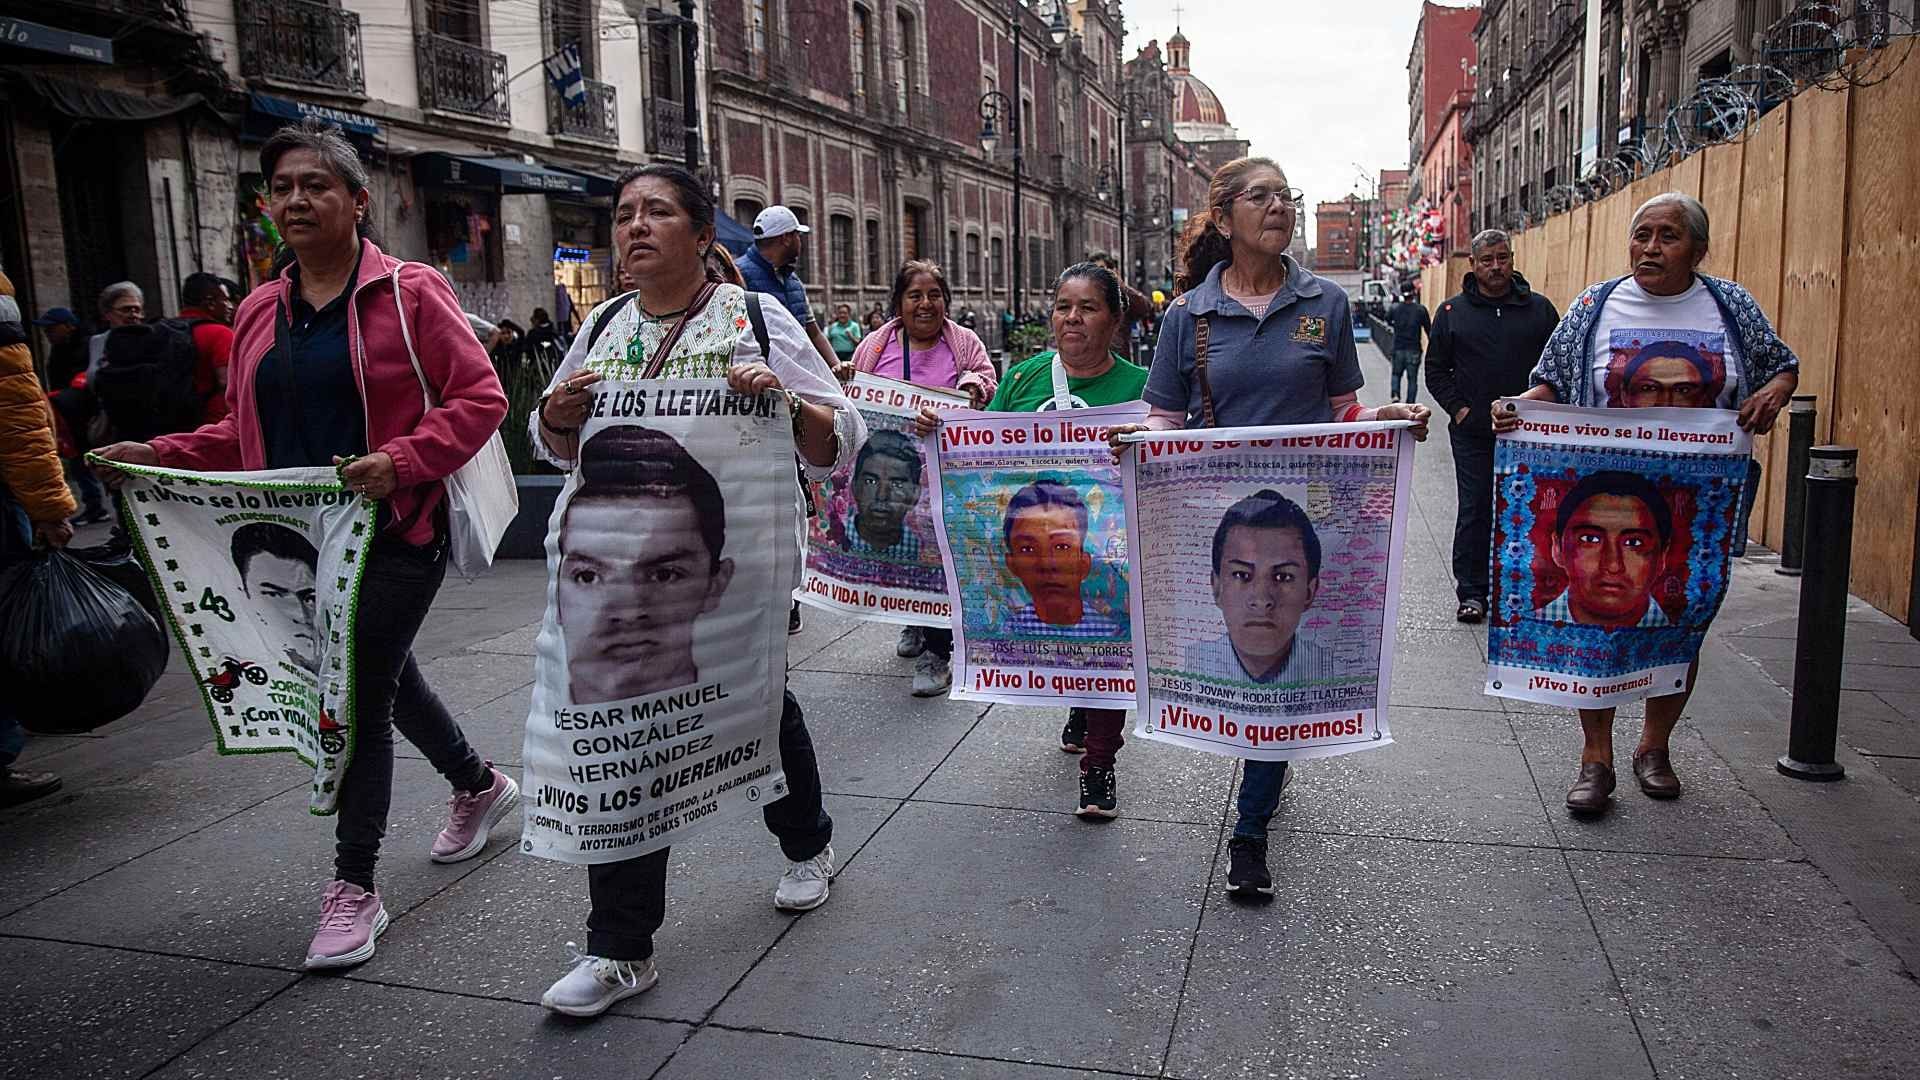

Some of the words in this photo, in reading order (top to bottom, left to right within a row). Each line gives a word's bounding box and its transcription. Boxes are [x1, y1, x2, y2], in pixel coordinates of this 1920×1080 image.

[611, 388, 647, 418] LOS
[654, 389, 777, 419] LLEVARON!
[865, 387, 885, 404] se
[888, 389, 905, 407] lo
[941, 426, 995, 452] ¡Vivo
[1001, 429, 1027, 444] se
[1034, 423, 1054, 443] lo
[1575, 424, 1610, 437] vivo
[1615, 428, 1632, 439] se
[1637, 426, 1652, 440] lo
[1658, 428, 1735, 445] llevaron!
[1031, 458, 1062, 466] Escocia,
[1065, 458, 1089, 466] quiero
[208, 495, 235, 509] se
[236, 491, 260, 509] lo
[200, 586, 236, 623] 43
[806, 576, 829, 597] ¡Con
[832, 583, 860, 607] VIDA
[863, 590, 877, 608] lo
[880, 595, 953, 618] queremos!
[1023, 643, 1050, 655] LUIS
[1057, 645, 1084, 657] LUNA
[1090, 645, 1134, 658] TORRES
[975, 668, 1023, 692] ¡Vivo
[1028, 670, 1046, 690] lo
[1161, 677, 1192, 692] JESÚS
[1198, 683, 1236, 700] JOVANY
[1242, 690, 1306, 704] RODRÍGUEZ
[1311, 685, 1364, 701] TLATEMPA
[1528, 675, 1568, 692] ¡Vivo
[1572, 681, 1588, 695] lo
[1592, 672, 1653, 698] queremos!
[241, 706, 280, 726] ¡Con
[279, 708, 307, 732] VIDA
[554, 707, 625, 731] CÉSAR
[631, 682, 729, 722] MANUEL
[572, 713, 705, 757] GONZÁLEZ
[1160, 704, 1213, 733] ¡Vivo
[1218, 713, 1238, 738] lo
[1244, 712, 1363, 746] queremos!
[568, 733, 715, 785] HERNÁNDEZ
[537, 784, 589, 815] ¡VIVOS
[599, 785, 642, 813] LOS
[649, 738, 761, 799] QUEREMOS!
[564, 823, 574, 836] EL
[577, 815, 645, 837] TERRORISMO
[647, 810, 660, 825] DE
[663, 794, 700, 818] ESTADO,
[702, 788, 714, 801] LA
[716, 763, 772, 795] SOLIDARIDAD
[579, 831, 646, 852] AYOTZINAPA
[648, 816, 681, 840] SOMXS
[682, 800, 719, 825] TODOXS
